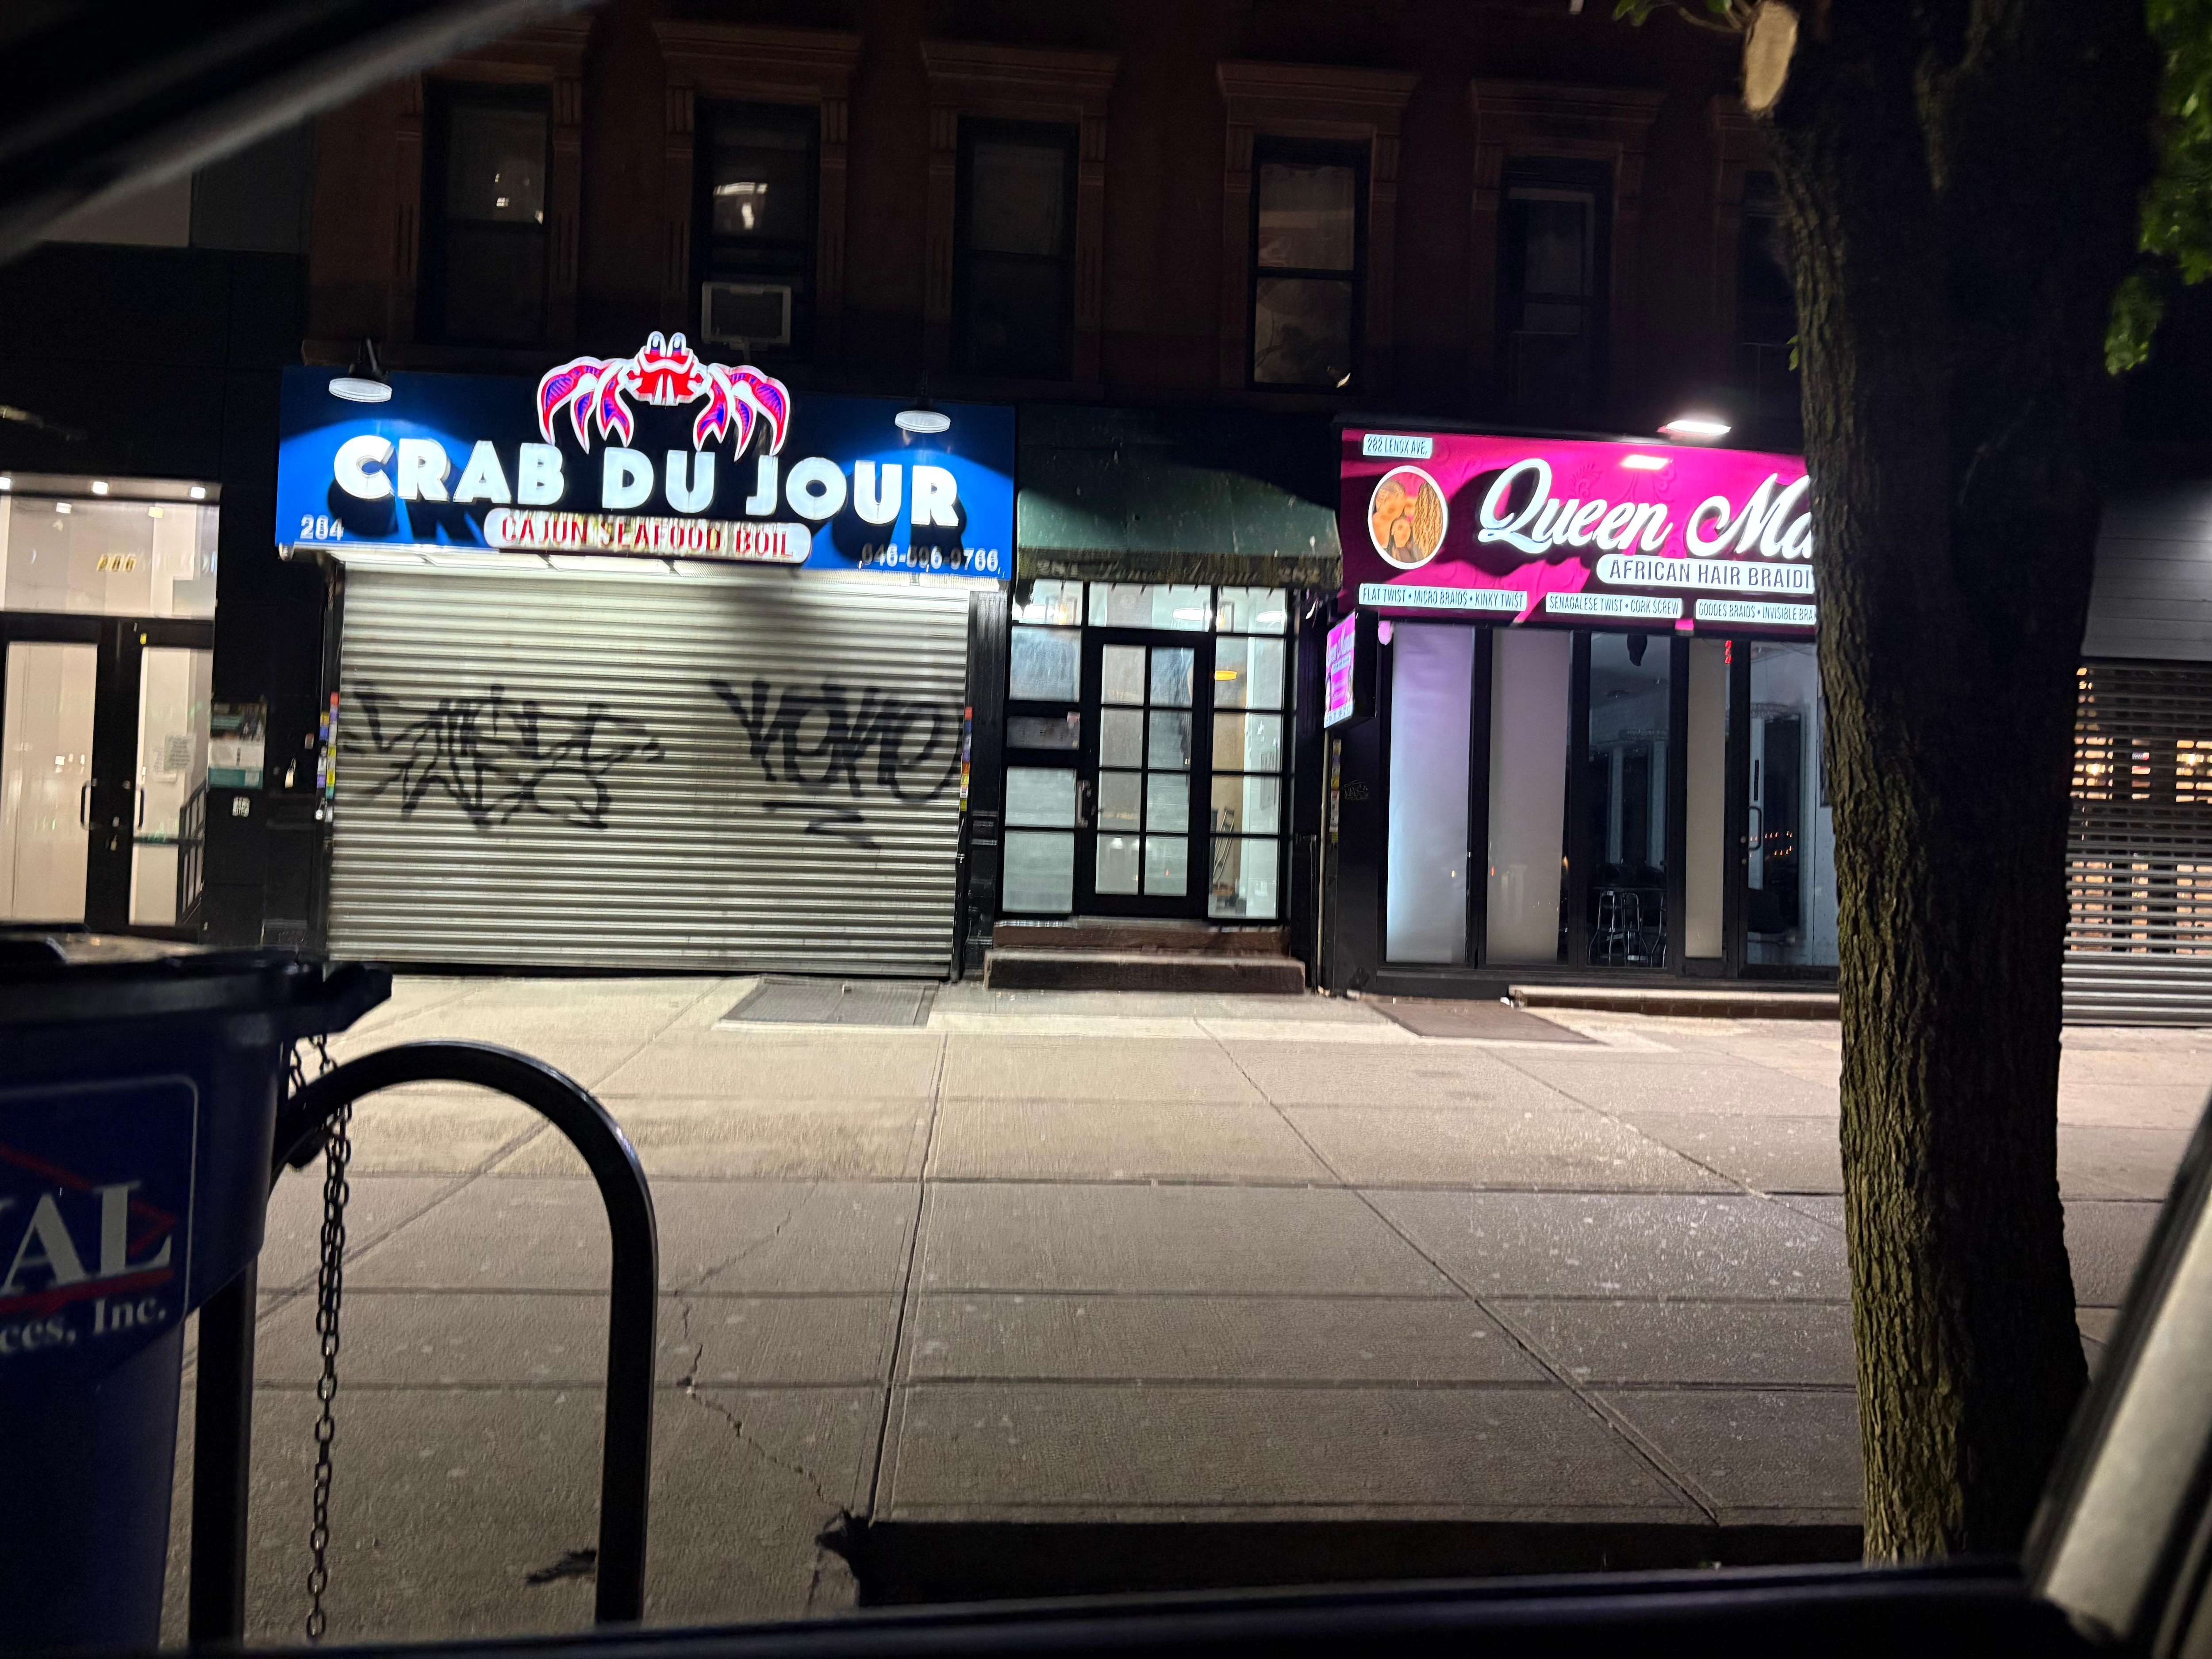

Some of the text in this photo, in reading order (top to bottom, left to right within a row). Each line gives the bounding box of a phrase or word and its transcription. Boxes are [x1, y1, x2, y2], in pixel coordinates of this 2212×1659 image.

[1367, 436, 1382, 452] 282
[1385, 438, 1409, 454] LENOX
[334, 435, 959, 527] CRAB DU JOUR
[1478, 458, 1673, 554] Queen
[502, 515, 794, 559] CAJUN SEAFOOD BOIL
[1609, 559, 1690, 582] AFRICAN
[1698, 564, 1740, 585] HAIR
[1363, 587, 1524, 608] FLAT TWIST MICRO BRAIDS KINKY TWIST
[1600, 598, 1623, 612] TWIST
[1631, 599, 1651, 614] CORK
[1653, 599, 1679, 615] SCREW
[1729, 603, 1755, 618] BRAIDS
[1763, 605, 1797, 620] INVISIBLE
[0, 1180, 172, 1297] AL
[92, 1296, 166, 1336] Inc.
